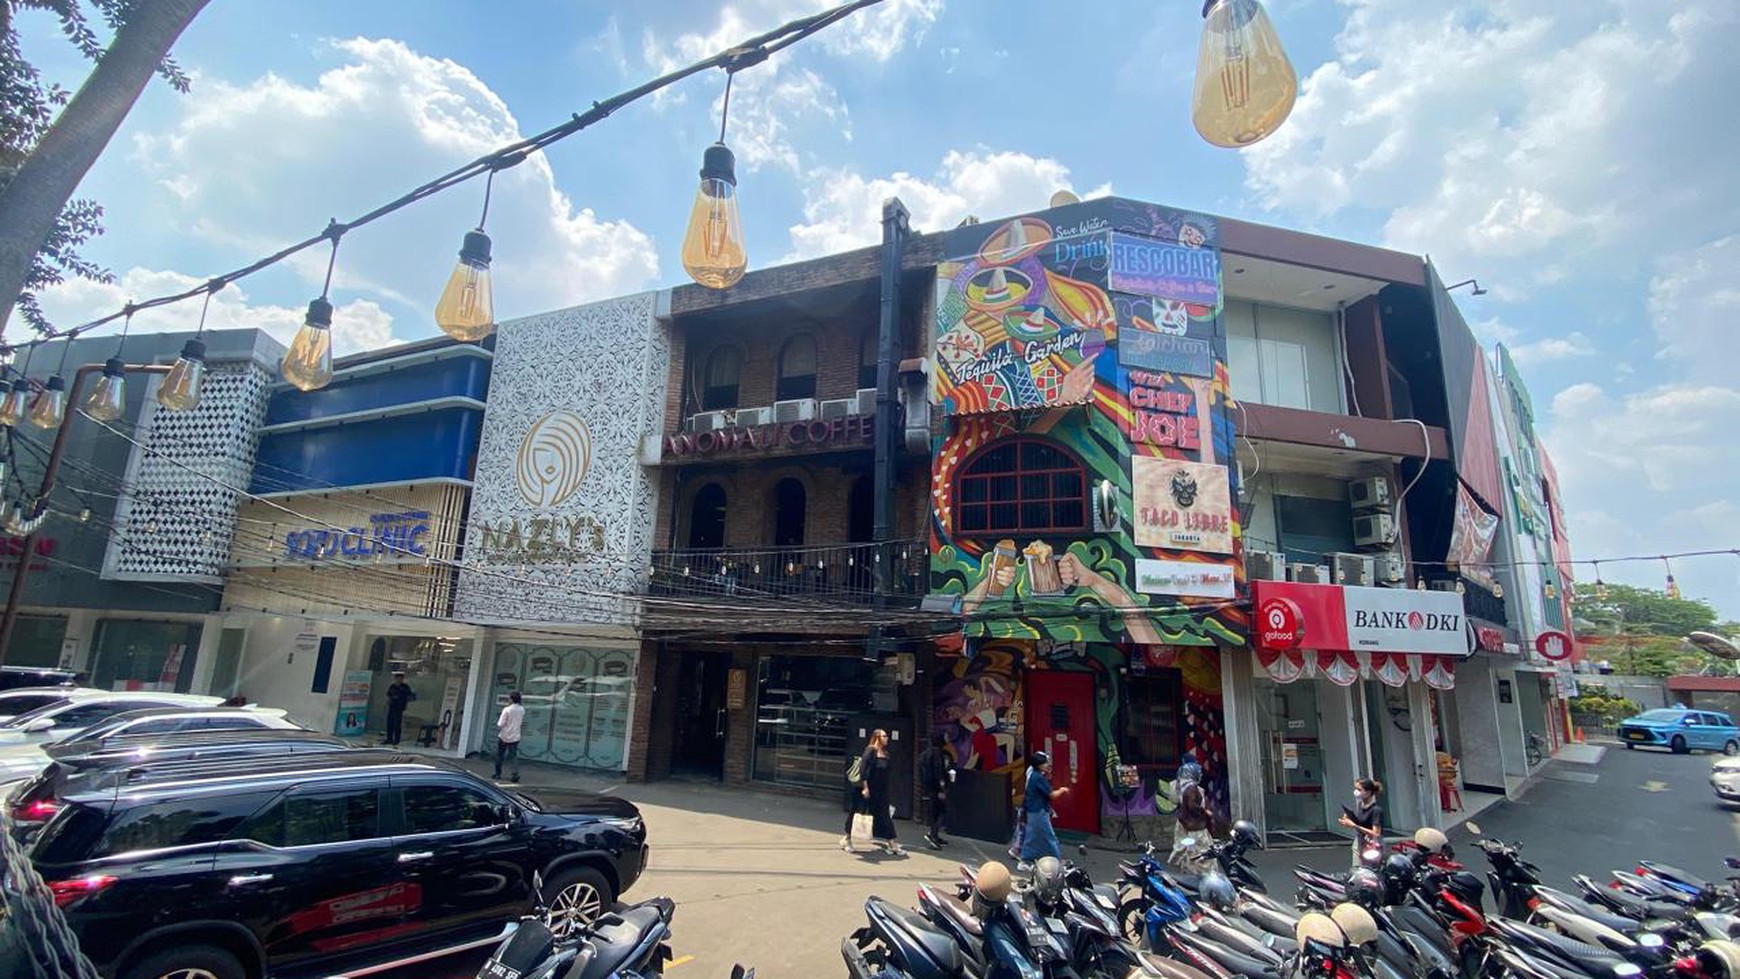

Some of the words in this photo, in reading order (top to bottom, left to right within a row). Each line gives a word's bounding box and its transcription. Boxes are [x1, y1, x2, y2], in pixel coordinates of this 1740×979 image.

[1055, 225, 1079, 239] Save
[1079, 216, 1110, 236] Water
[956, 348, 1012, 384] Tequila
[1024, 331, 1086, 363] Garden
[664, 427, 781, 455] ANOMALI
[787, 415, 875, 445] COFFE
[1130, 410, 1202, 449] JOE
[1141, 507, 1179, 527] TACO
[1184, 511, 1229, 533] LIBRE
[1354, 609, 1408, 629] BANK
[1425, 613, 1459, 632] DKI
